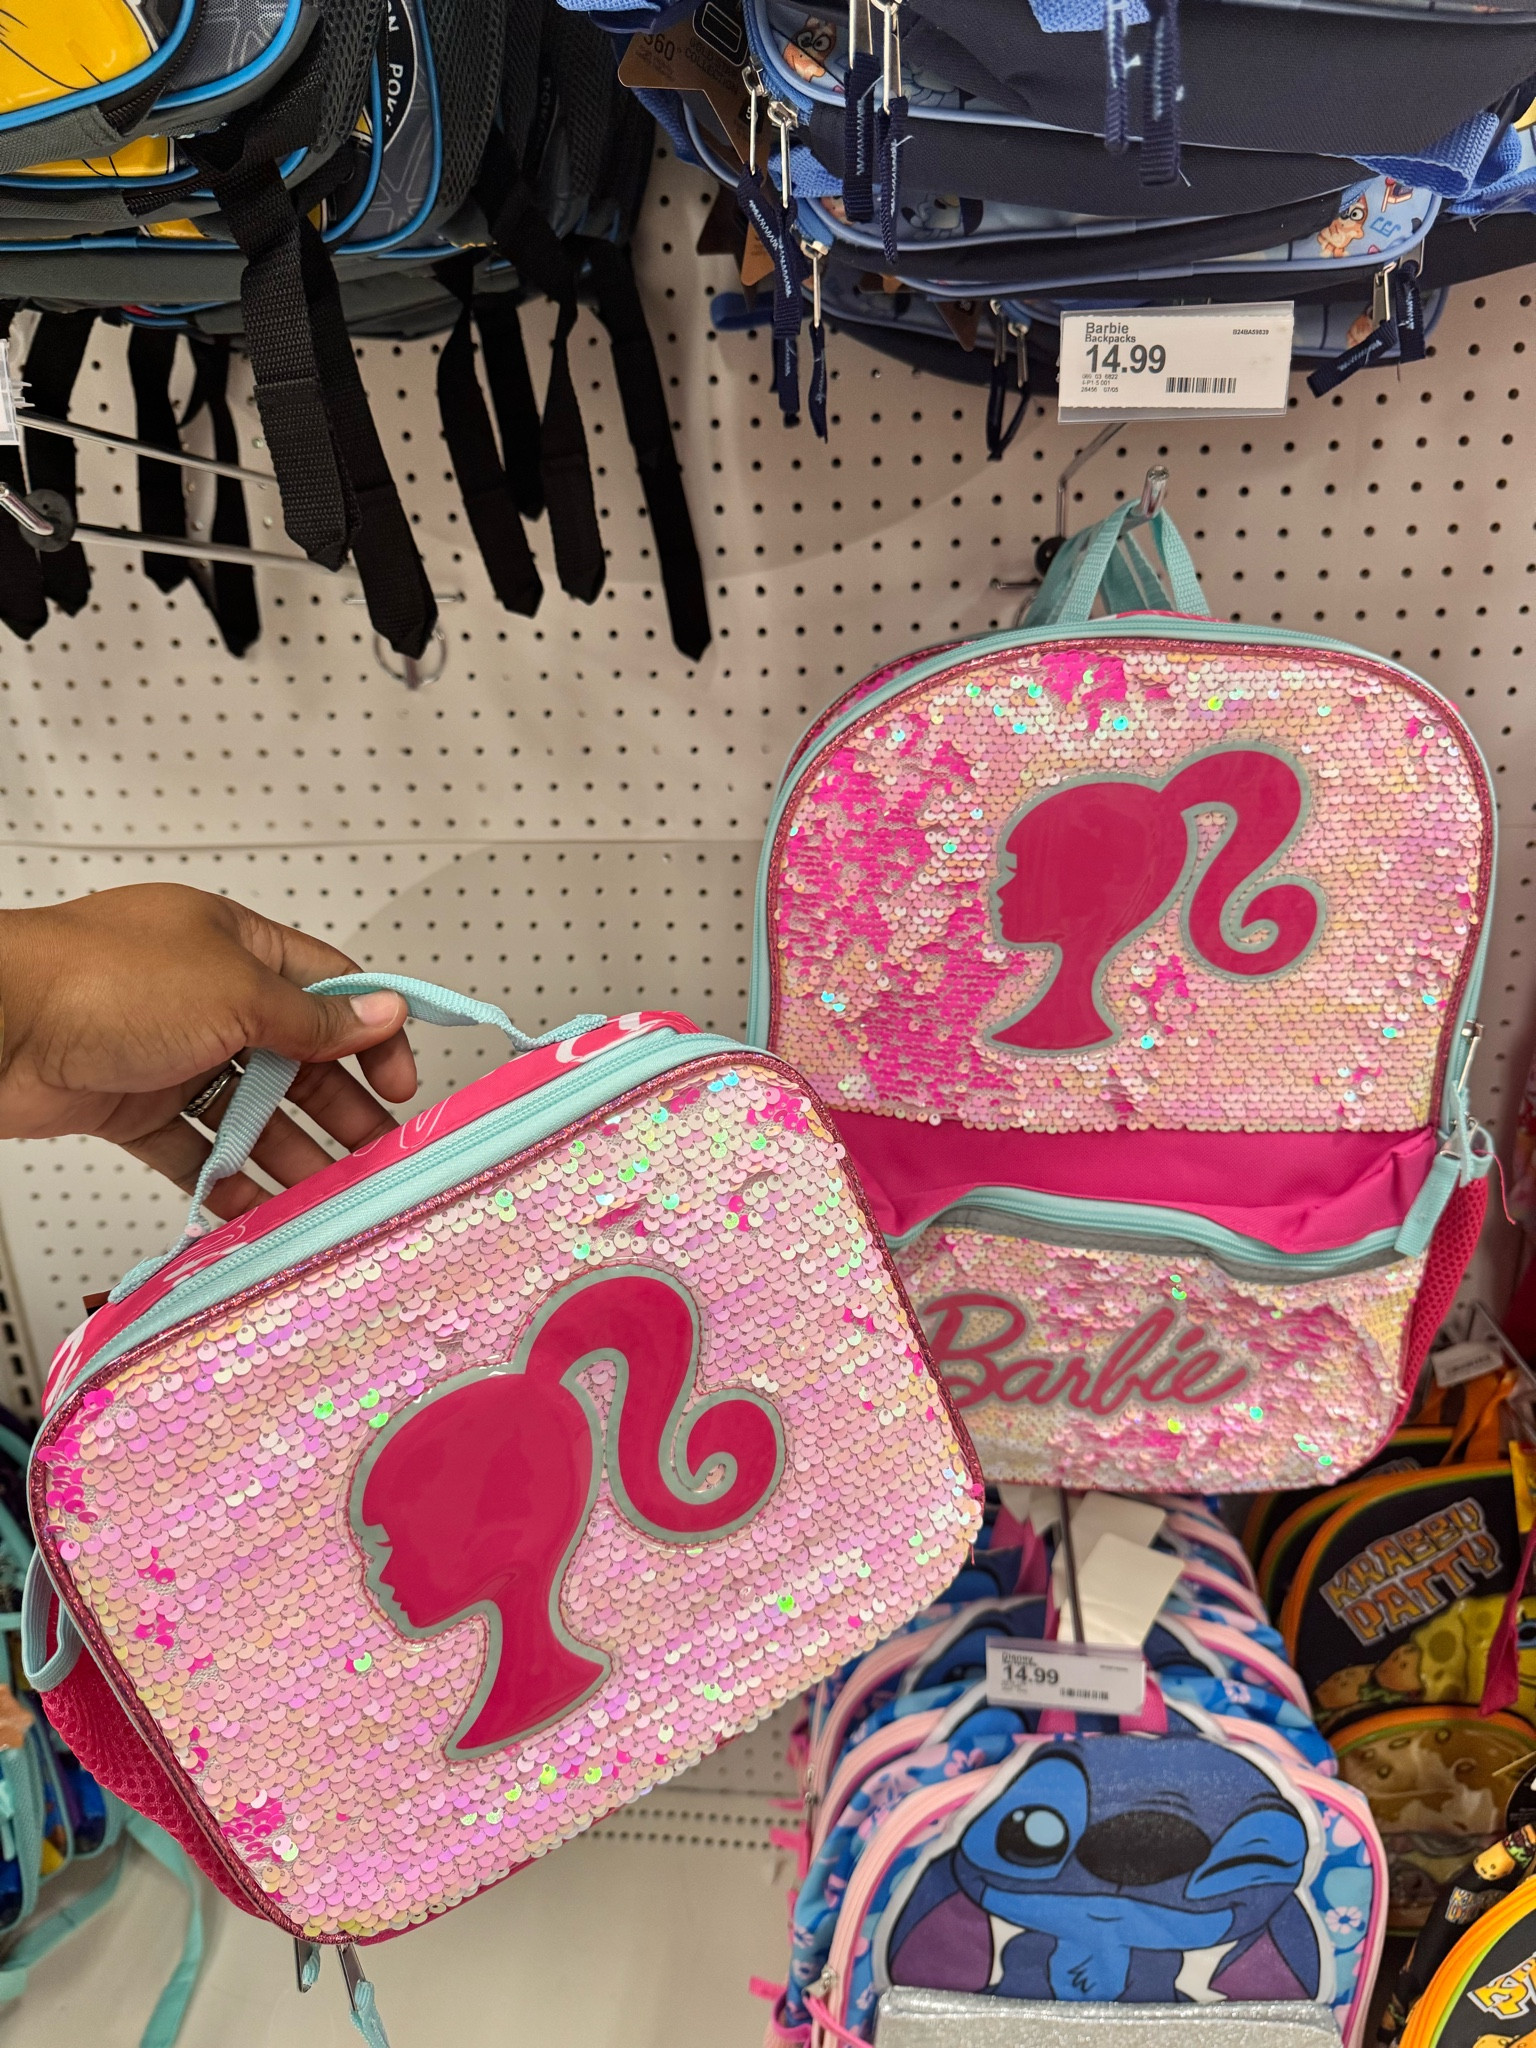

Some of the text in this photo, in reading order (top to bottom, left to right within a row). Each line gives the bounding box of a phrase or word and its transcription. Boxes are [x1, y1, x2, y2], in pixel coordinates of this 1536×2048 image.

[1084, 333, 1137, 344] Backpacks
[1085, 322, 1130, 335] Barbie
[1085, 344, 1167, 374] 14.99
[921, 1292, 1247, 1417] Barbie
[1323, 1499, 1483, 1613] KRABBY
[1344, 1531, 1500, 1643] PATTY
[1003, 1665, 1059, 1685] 14.99
